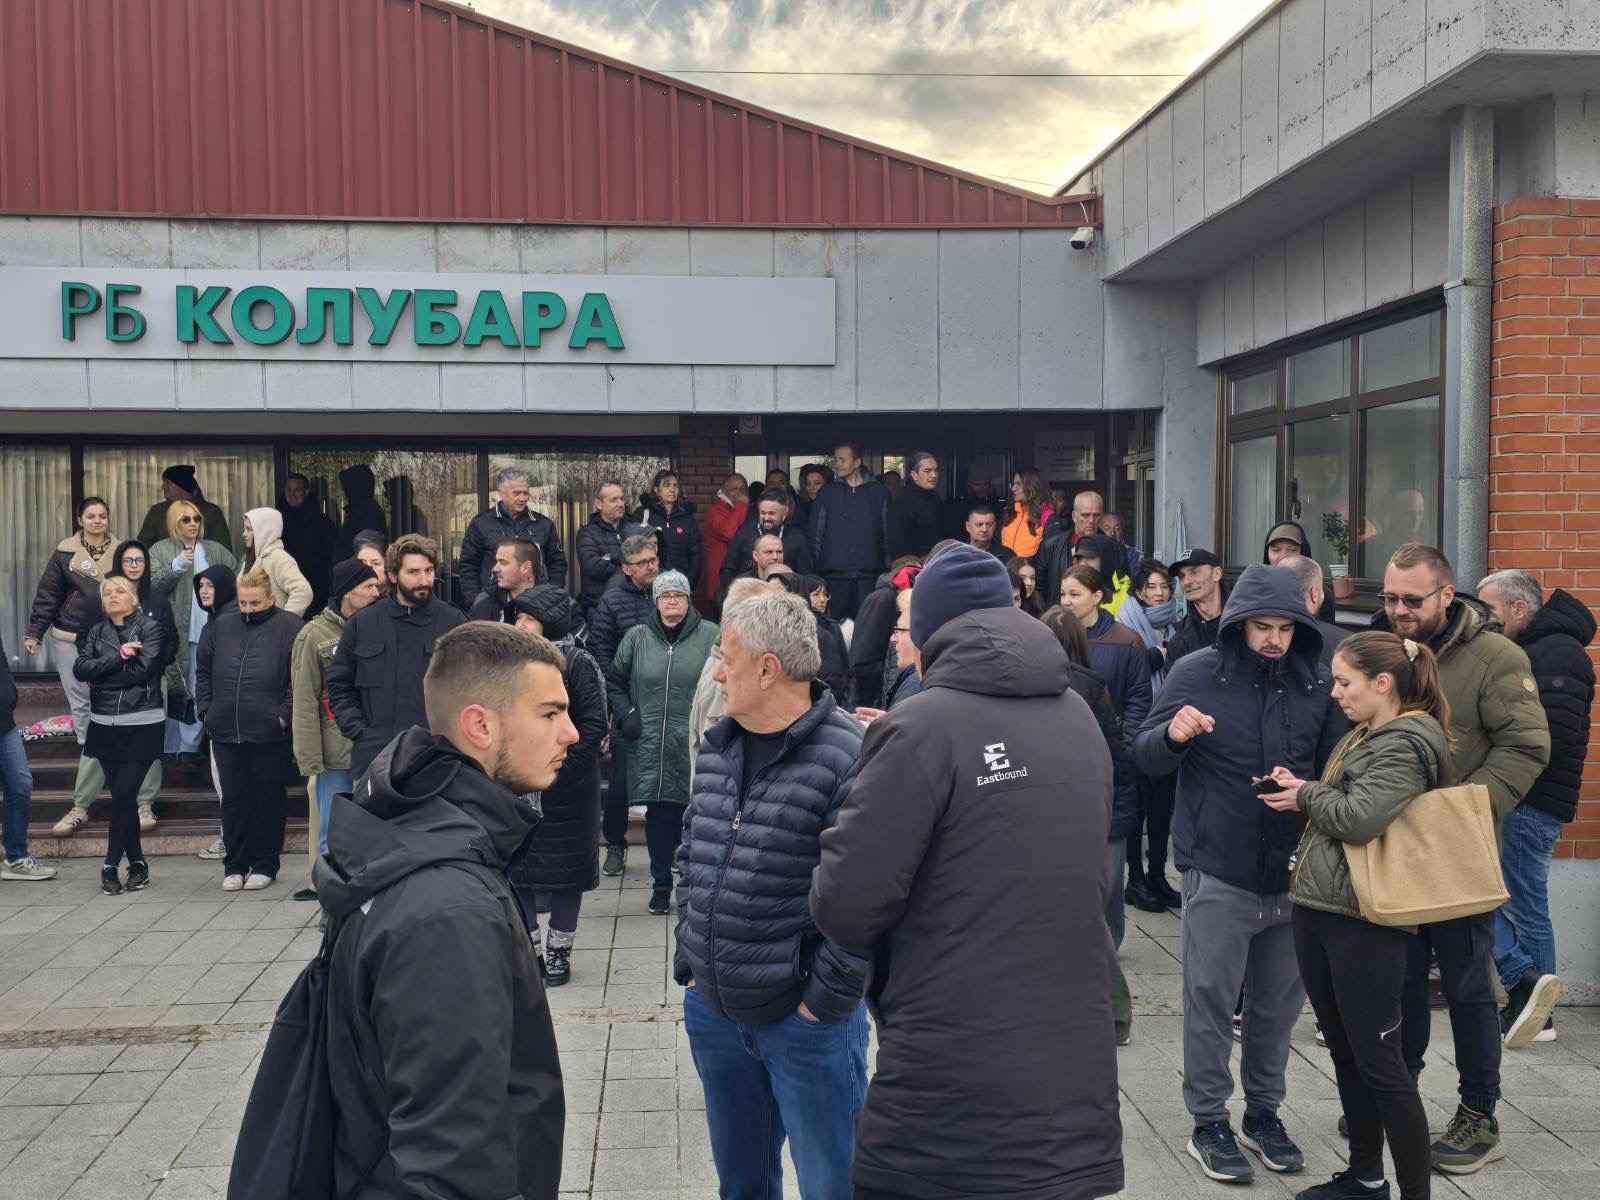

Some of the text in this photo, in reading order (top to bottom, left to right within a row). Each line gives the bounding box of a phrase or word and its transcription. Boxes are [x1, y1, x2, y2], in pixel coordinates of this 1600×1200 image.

[61, 281, 626, 350] РБ КОЛУБАРА
[976, 766, 1028, 786] Eastbound
